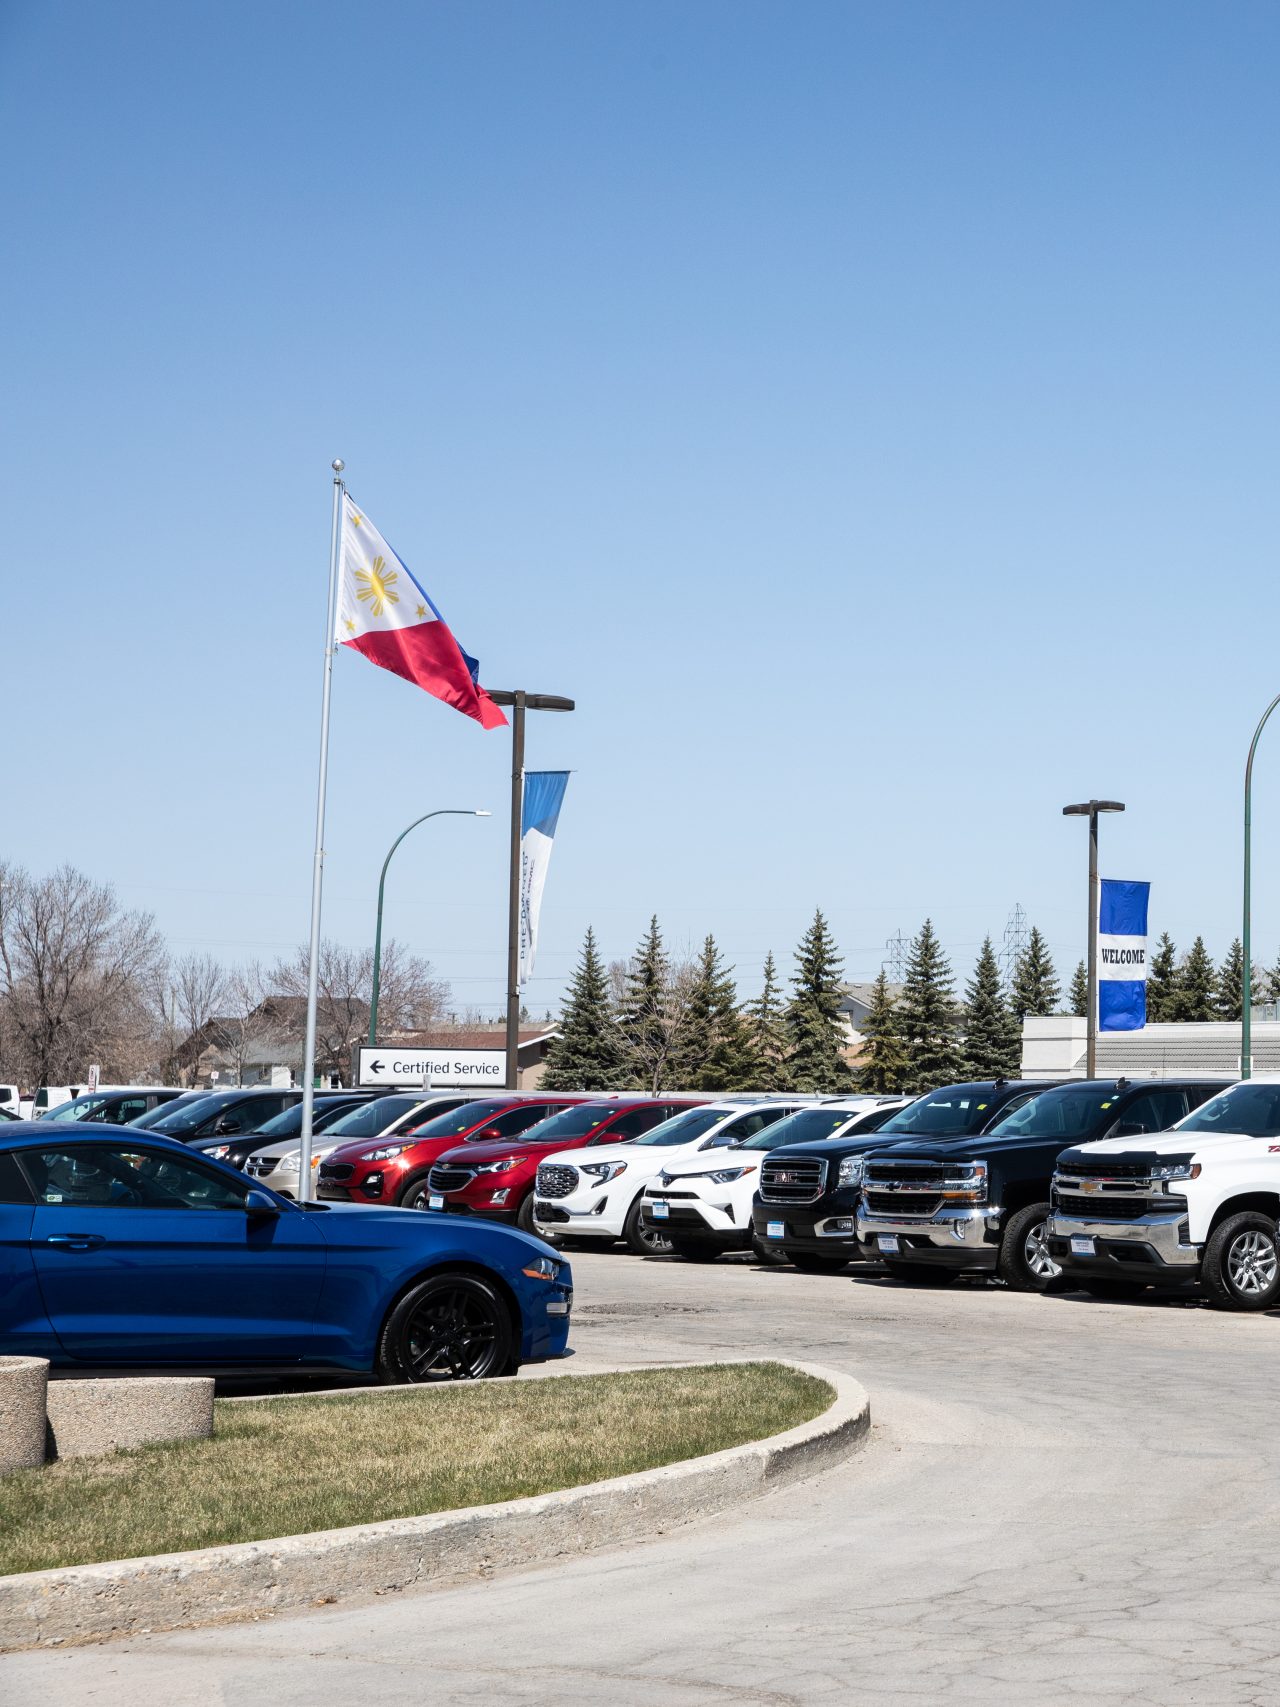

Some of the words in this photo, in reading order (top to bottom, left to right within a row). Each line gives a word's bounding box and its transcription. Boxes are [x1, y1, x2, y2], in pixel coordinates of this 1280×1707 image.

[1102, 948, 1145, 964] WELCOME
[393, 1061, 450, 1074] Certified
[454, 1062, 500, 1075] Service
[774, 1172, 799, 1184] GMC
